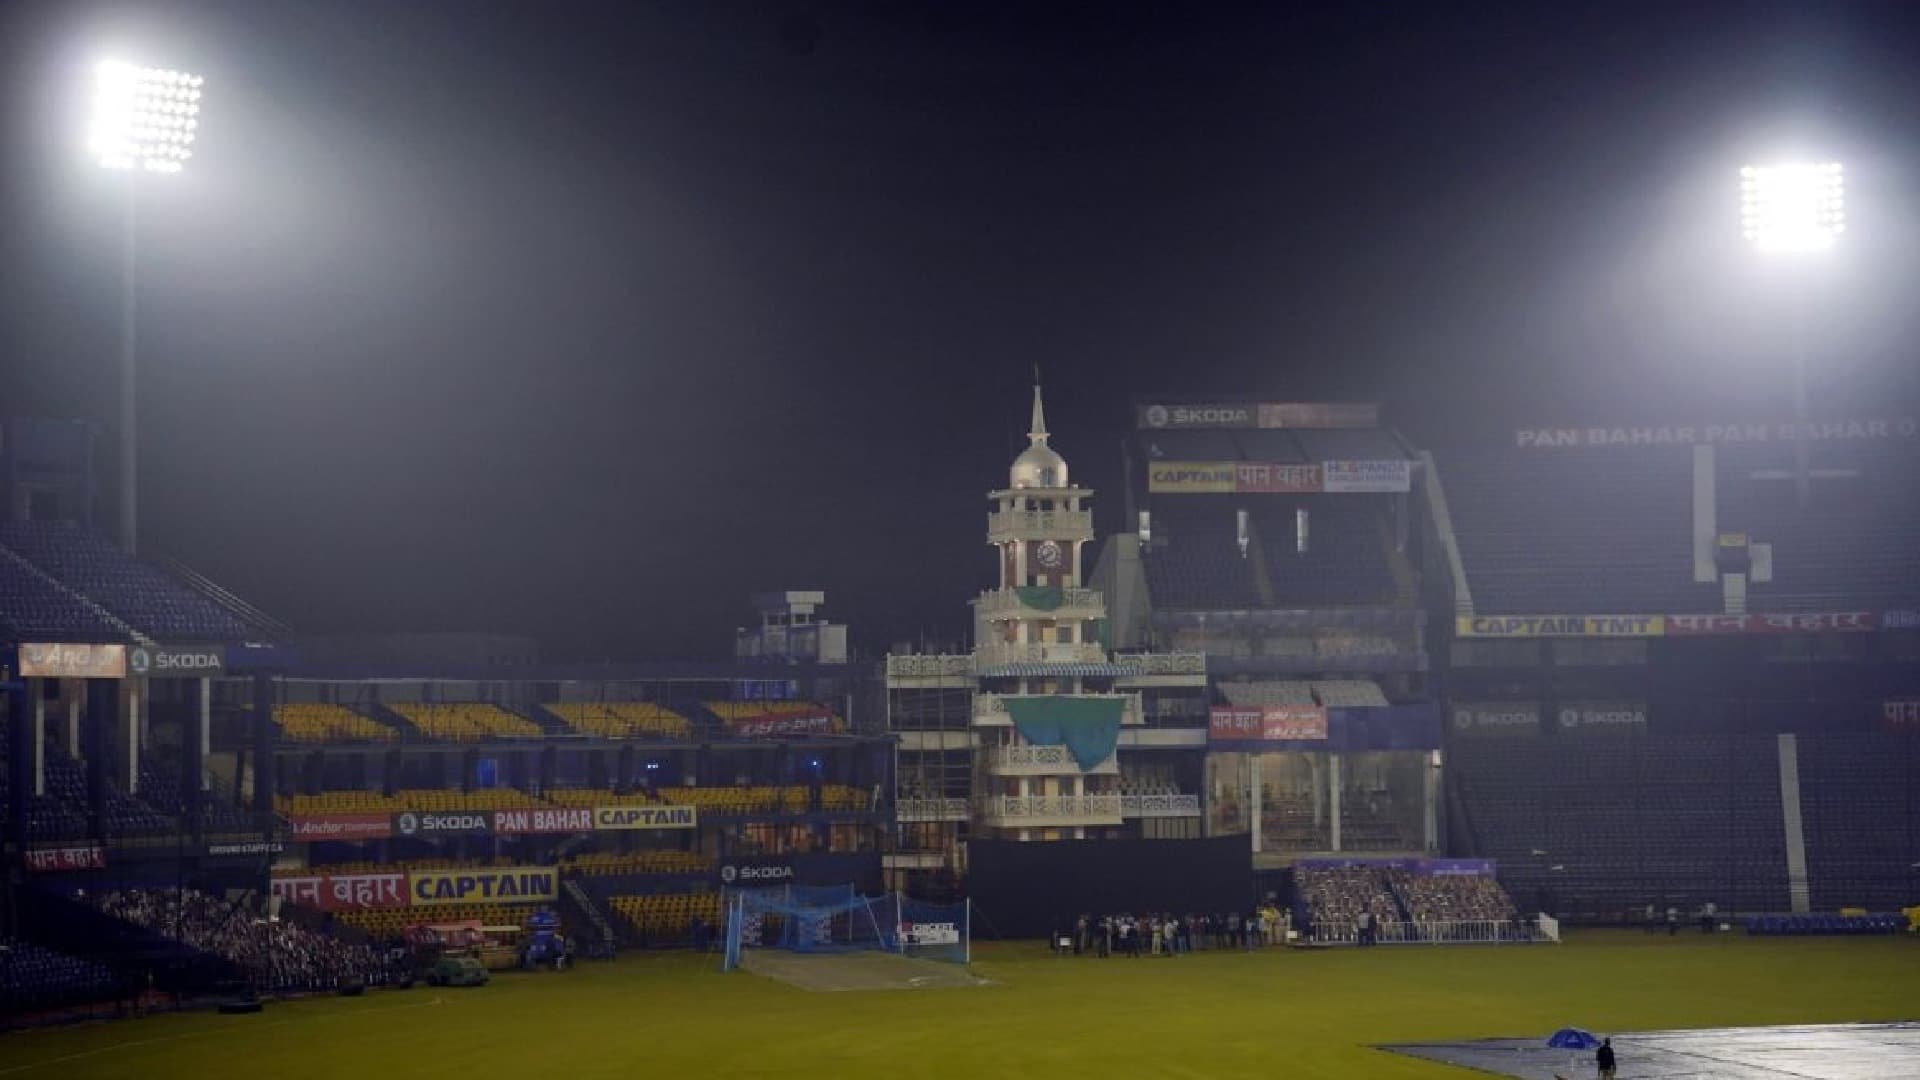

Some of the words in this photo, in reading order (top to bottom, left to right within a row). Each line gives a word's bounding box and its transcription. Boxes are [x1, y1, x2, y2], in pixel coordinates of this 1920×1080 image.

[1517, 429, 1577, 447] PAN
[1588, 426, 1696, 445] BAHAR
[1704, 425, 1767, 442] PAN
[1777, 421, 1888, 441] BAHAR
[1153, 471, 1234, 483] CAPTAIN
[1236, 464, 1271, 484] पान
[1274, 464, 1320, 488] बहार
[1472, 617, 1585, 634] CAPTAIN
[1591, 617, 1648, 633] TMT
[1667, 613, 1751, 629] पान
[1761, 612, 1871, 630] बहार
[301, 819, 345, 834] Anchor
[495, 811, 528, 830] PAN
[534, 810, 592, 829] BAHAR
[600, 809, 691, 825] CAPTAIN
[329, 873, 404, 907] बहार
[416, 874, 553, 899] CAPTAIN
